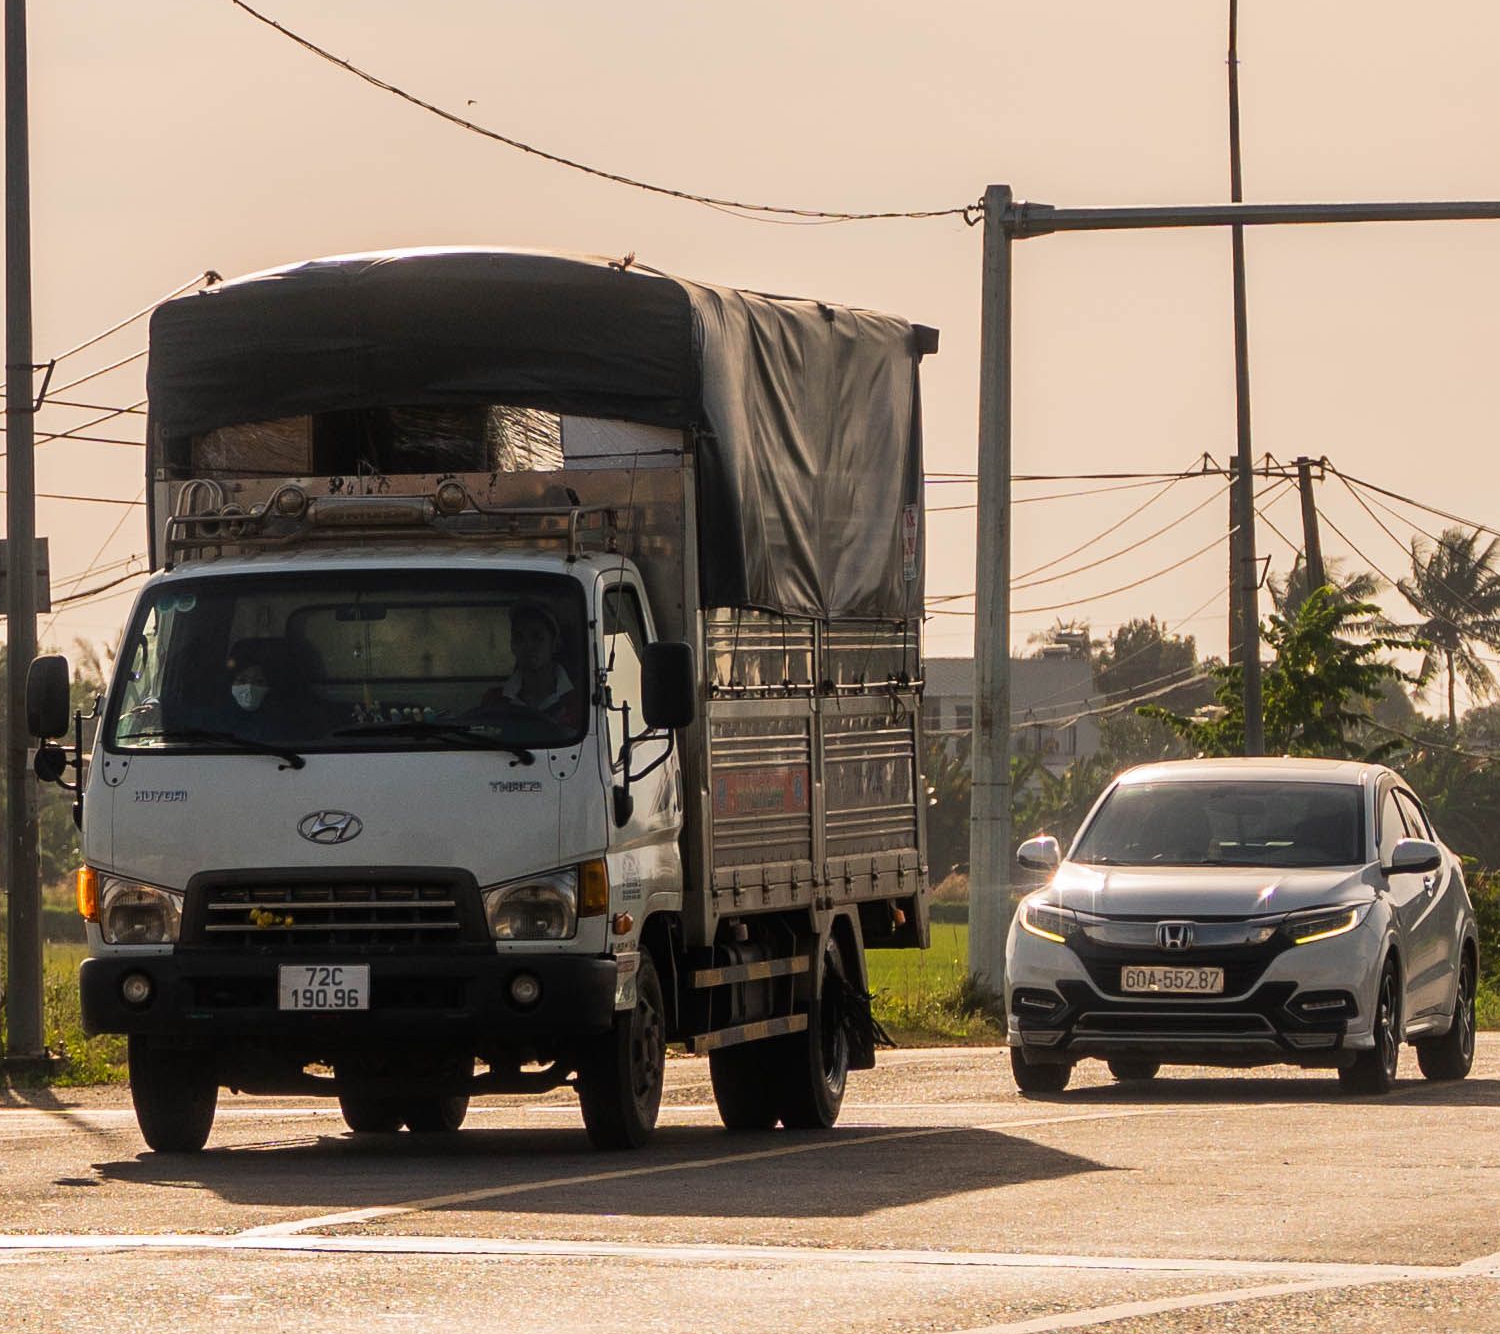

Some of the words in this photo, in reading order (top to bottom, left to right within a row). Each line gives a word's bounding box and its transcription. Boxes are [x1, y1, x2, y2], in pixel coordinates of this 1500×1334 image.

[305, 967, 343, 987] 72C
[1125, 970, 1220, 990] 60A-552.87
[291, 988, 360, 1008] 190.96
